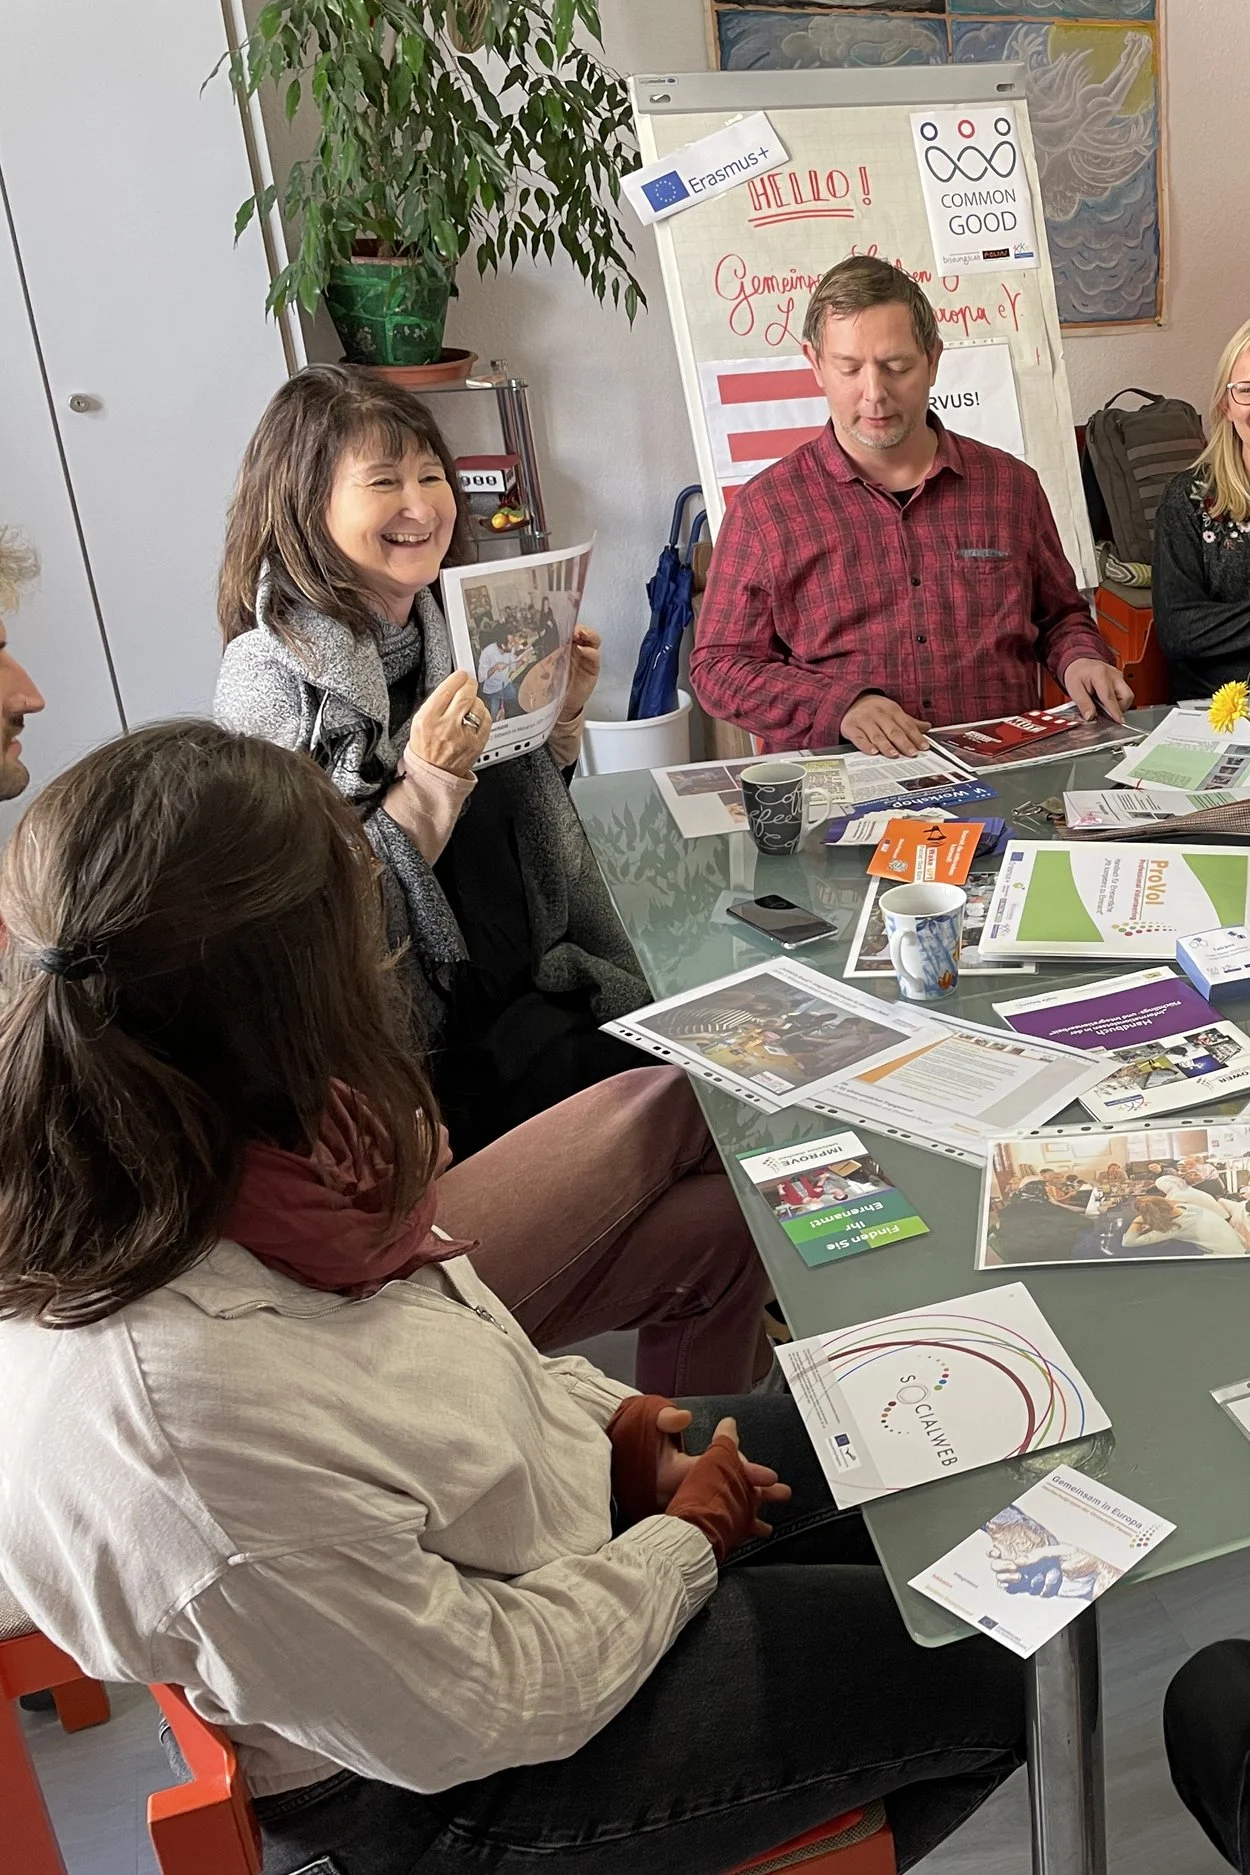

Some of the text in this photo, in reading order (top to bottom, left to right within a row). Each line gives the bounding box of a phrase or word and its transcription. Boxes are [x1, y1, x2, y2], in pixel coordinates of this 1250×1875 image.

[689, 145, 769, 194] Erasmus+
[941, 188, 1016, 209] COMMON
[949, 210, 1017, 236] GOOD
[934, 303, 991, 337] uropa
[928, 392, 980, 411] RVUS!
[893, 790, 969, 808] Workshop
[1145, 859, 1169, 905] ProVol
[1096, 1019, 1153, 1036] Handbuch
[1122, 1012, 1137, 1020] und
[781, 1146, 843, 1167] IMPROVE
[809, 1201, 884, 1228] Ehrenamt!
[845, 1220, 866, 1232] Ihr
[826, 1224, 900, 1251] Finden Sie
[1052, 1475, 1143, 1530] Gemeinsam in Europa
